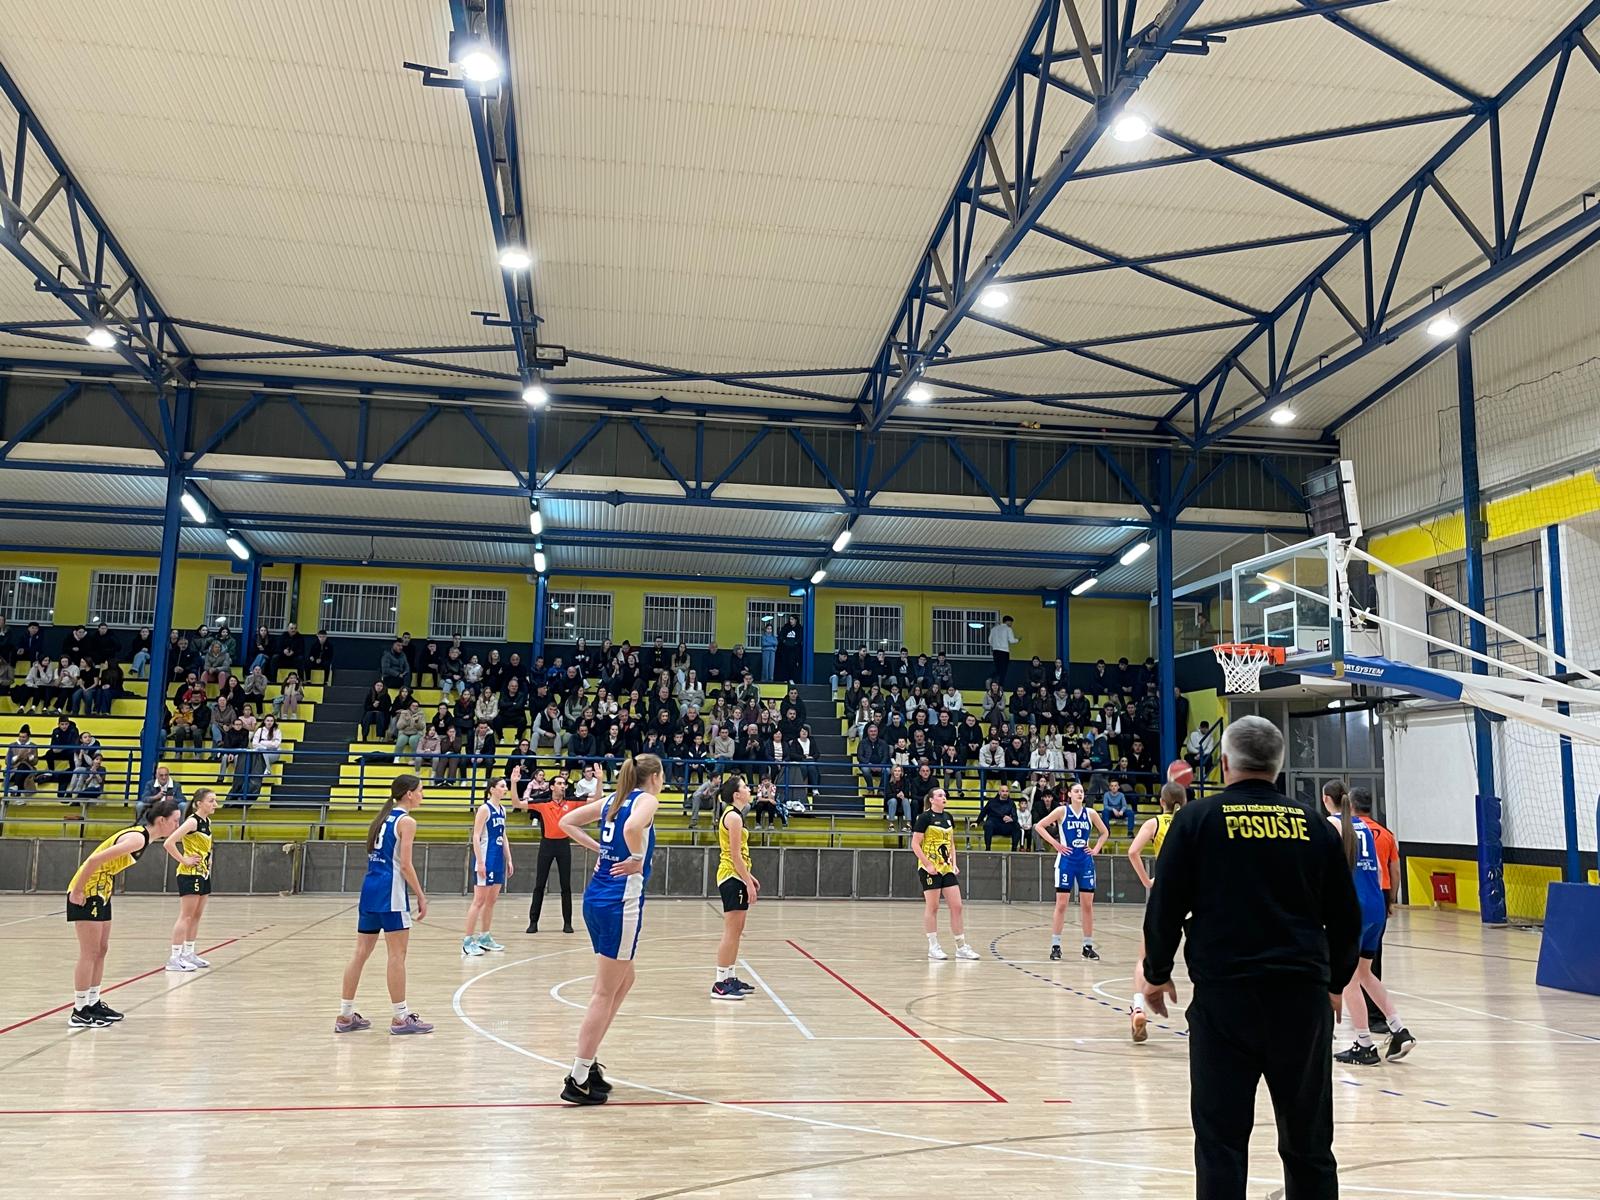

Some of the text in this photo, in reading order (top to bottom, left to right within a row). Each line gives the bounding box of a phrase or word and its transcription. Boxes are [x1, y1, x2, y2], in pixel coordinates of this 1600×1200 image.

[1355, 665, 1384, 676] SYSTEM
[1067, 820, 1089, 831] LIVNO
[1225, 812, 1311, 841] POSUŠJE
[602, 820, 616, 843] 5
[1076, 829, 1082, 838] 3
[488, 871, 494, 879] 4
[1062, 873, 1068, 883] 3
[194, 882, 200, 892] 5
[90, 906, 98, 918] 4
